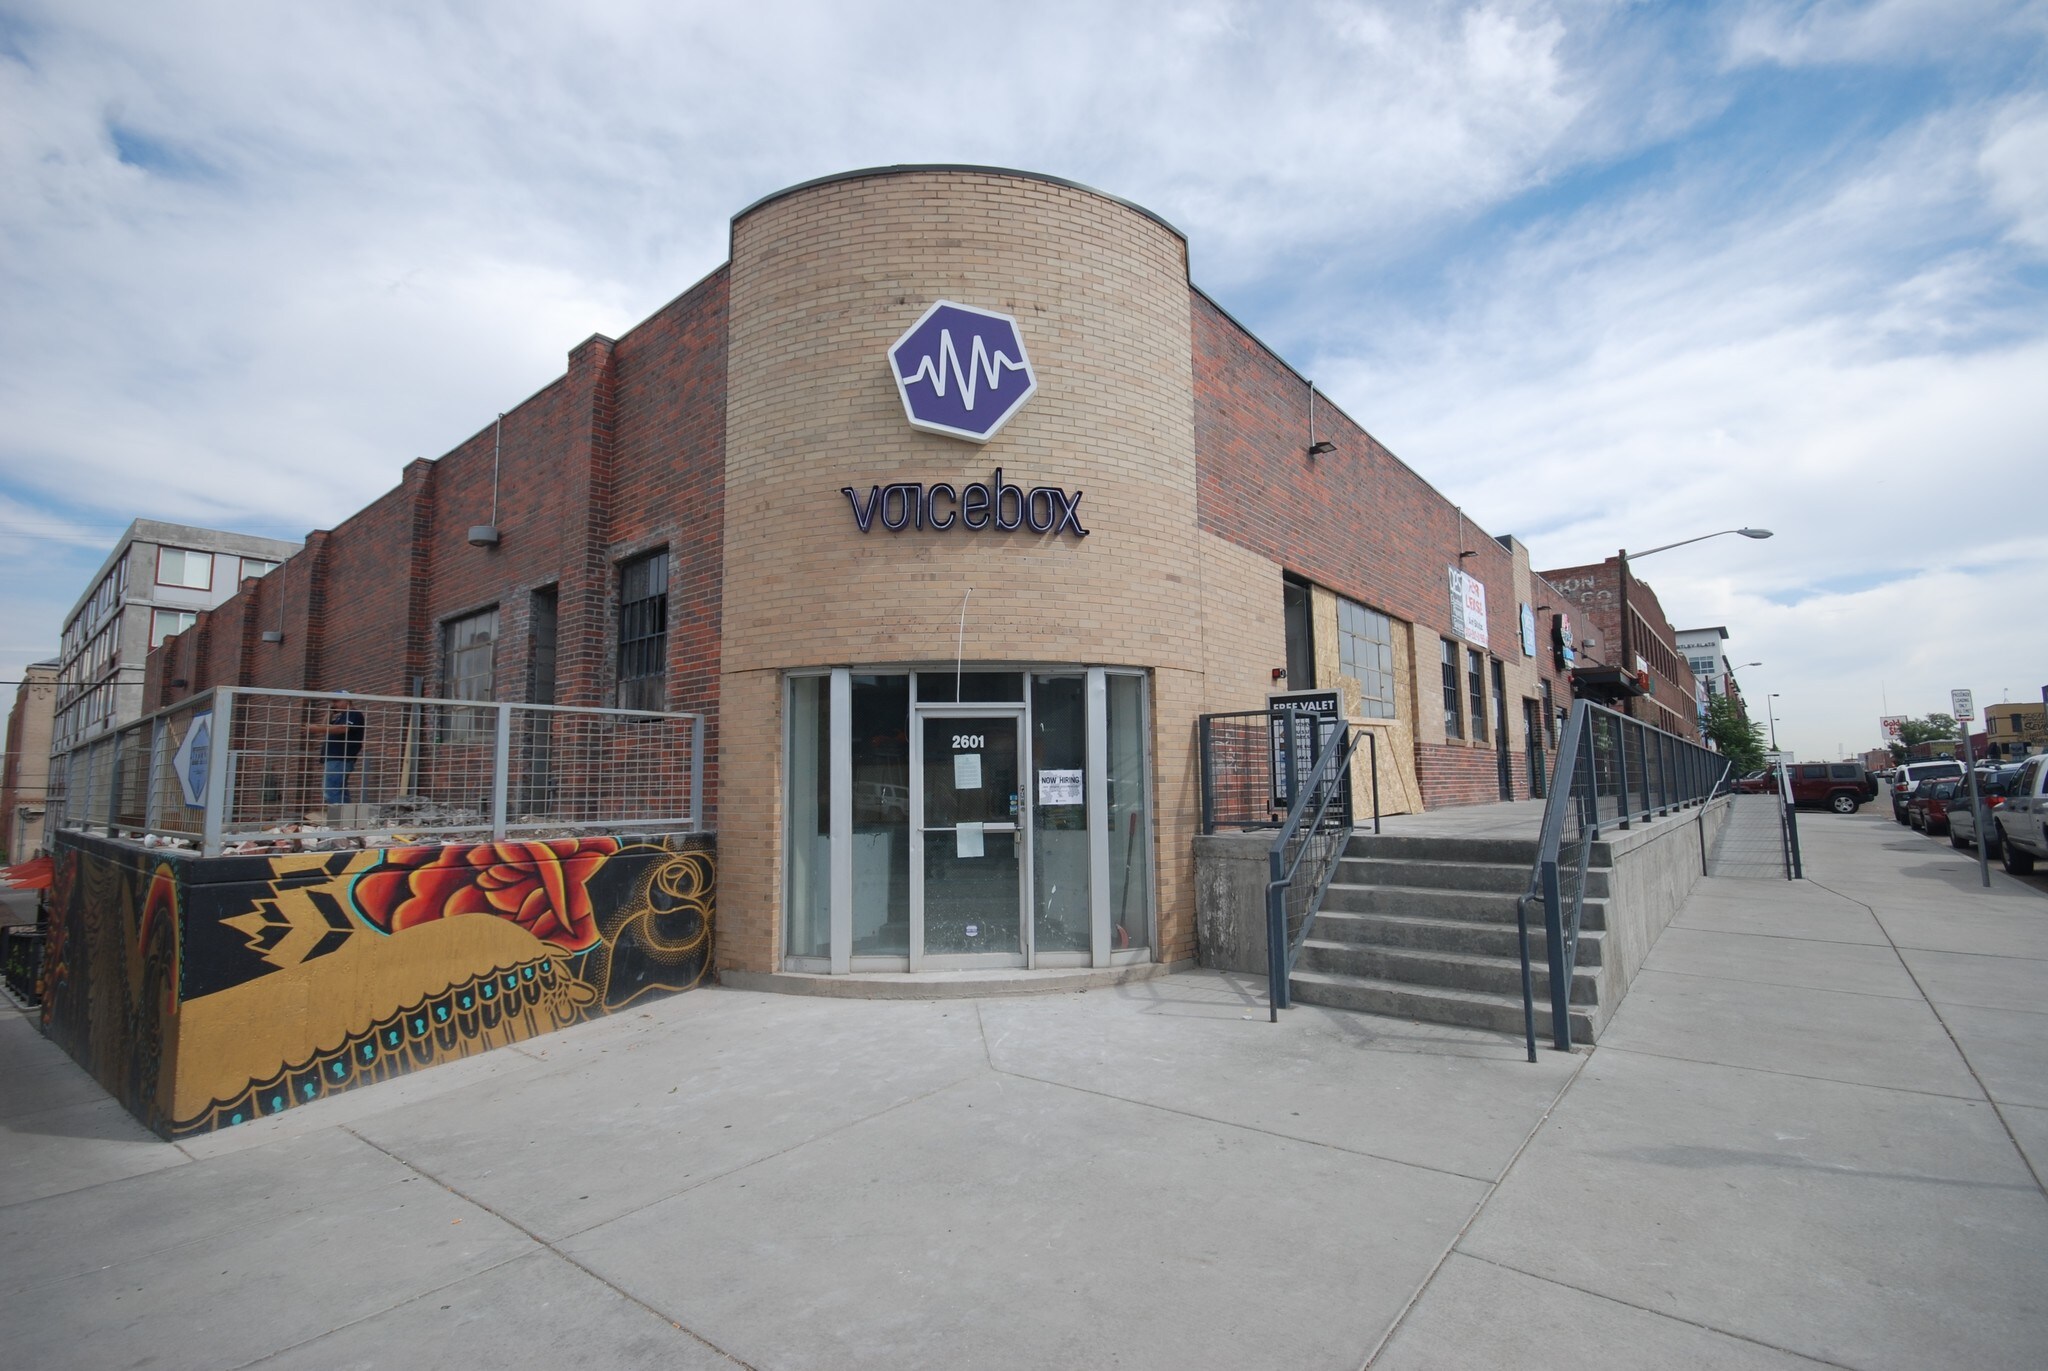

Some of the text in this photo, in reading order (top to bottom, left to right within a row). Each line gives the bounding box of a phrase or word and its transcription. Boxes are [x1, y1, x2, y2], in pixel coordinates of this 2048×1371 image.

[841, 467, 1090, 536] voicebox
[1273, 700, 1335, 711] FREE VALET
[1883, 719, 1901, 727] Gold
[952, 735, 985, 748] 2601
[1041, 776, 1080, 784] NOW HIRING
